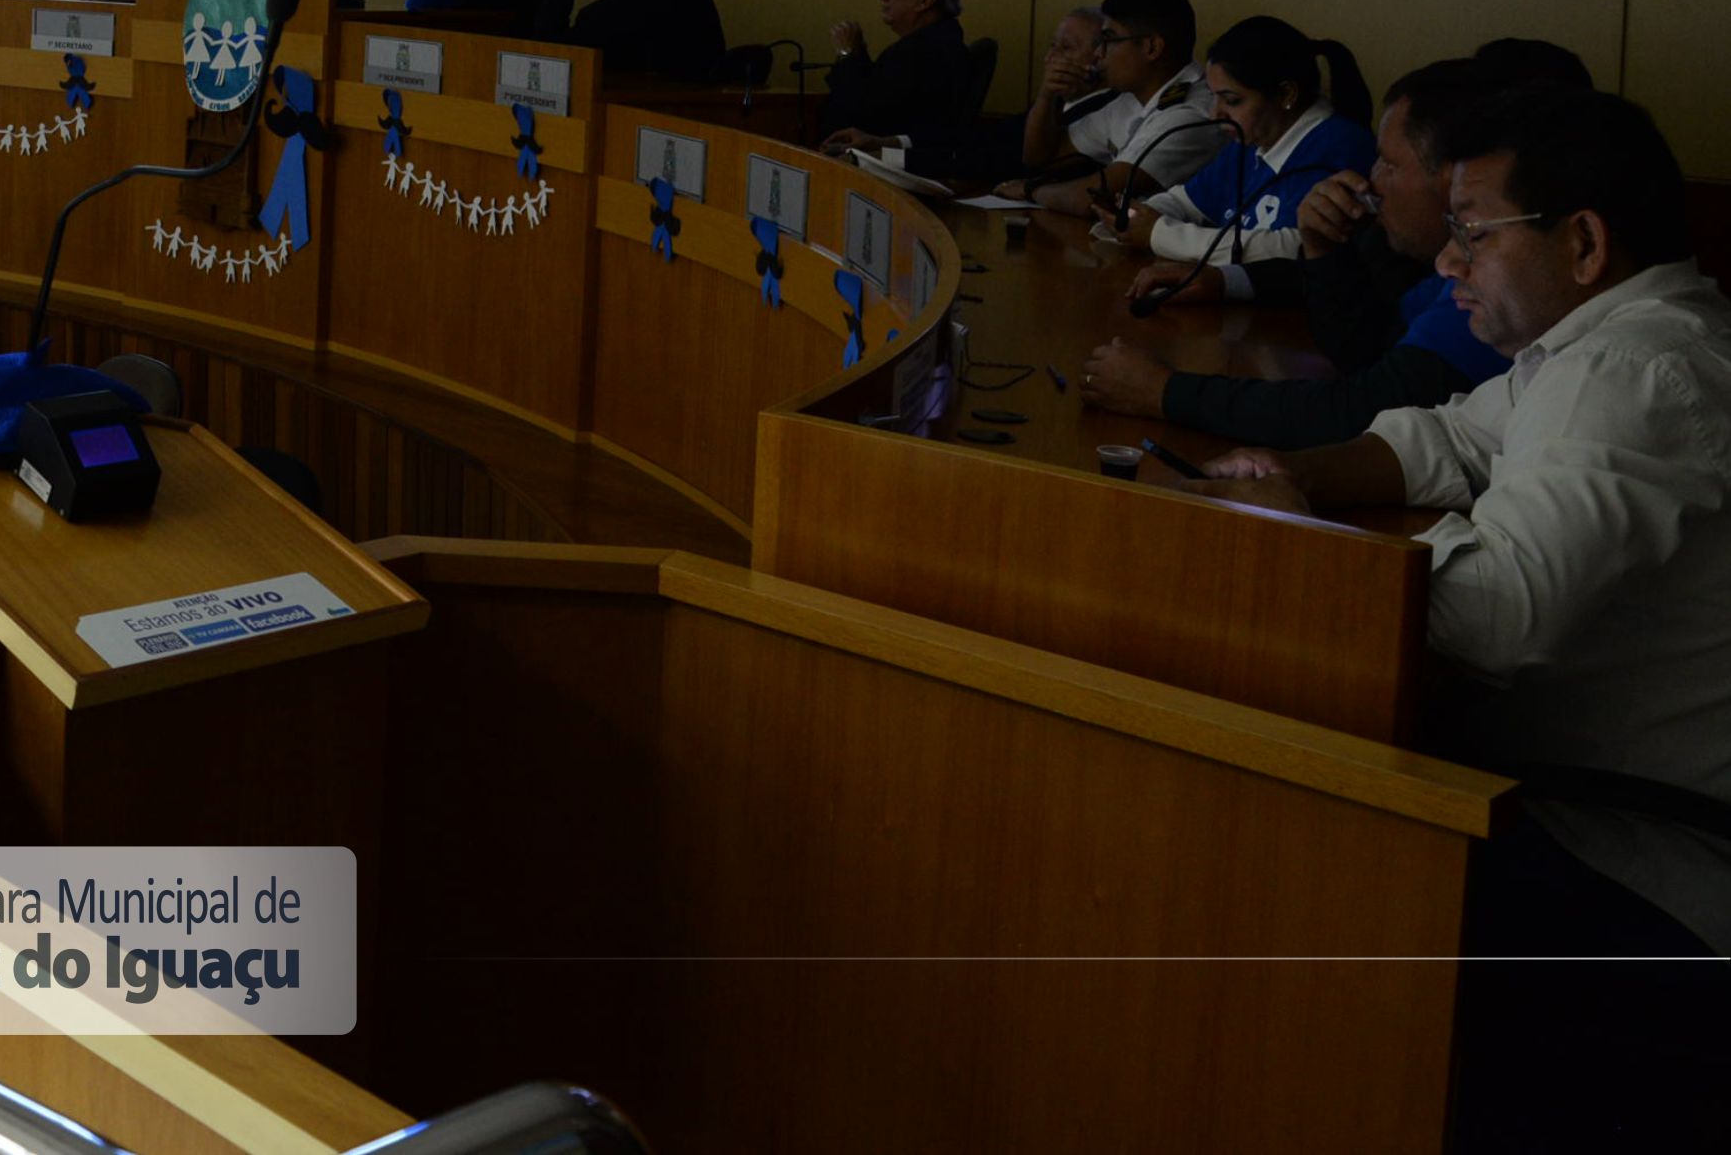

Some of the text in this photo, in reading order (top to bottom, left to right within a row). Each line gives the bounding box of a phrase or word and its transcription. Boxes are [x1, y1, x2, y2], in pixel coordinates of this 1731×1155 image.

[123, 591, 284, 632] Estamos ao VIVO
[172, 593, 220, 608] ATENÇÃO
[246, 608, 308, 630] facebook
